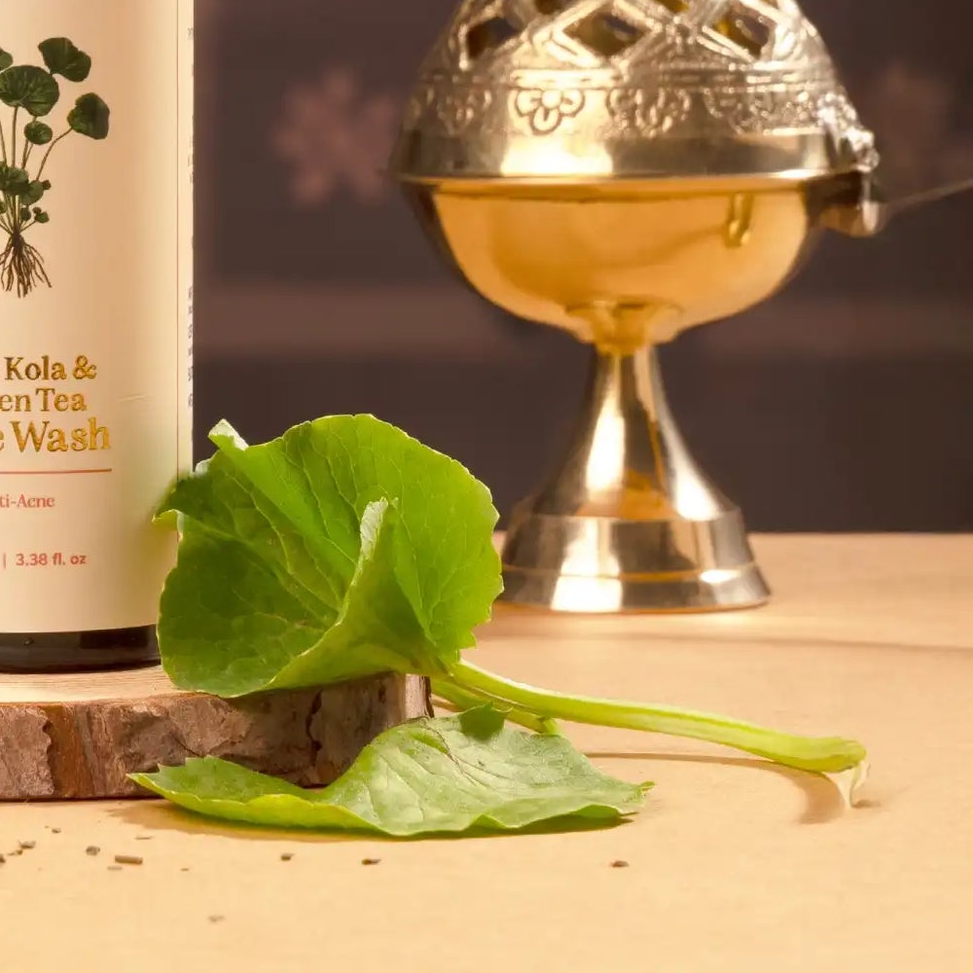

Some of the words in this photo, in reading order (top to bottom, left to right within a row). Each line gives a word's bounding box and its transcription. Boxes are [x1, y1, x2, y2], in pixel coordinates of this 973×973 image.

[4, 355, 67, 381] Kola
[72, 354, 98, 380] &
[35, 387, 88, 412] Tea
[10, 416, 112, 453] Wash
[15, 552, 48, 567] 3.38
[52, 552, 66, 566] fl.
[70, 554, 87, 565] oz
